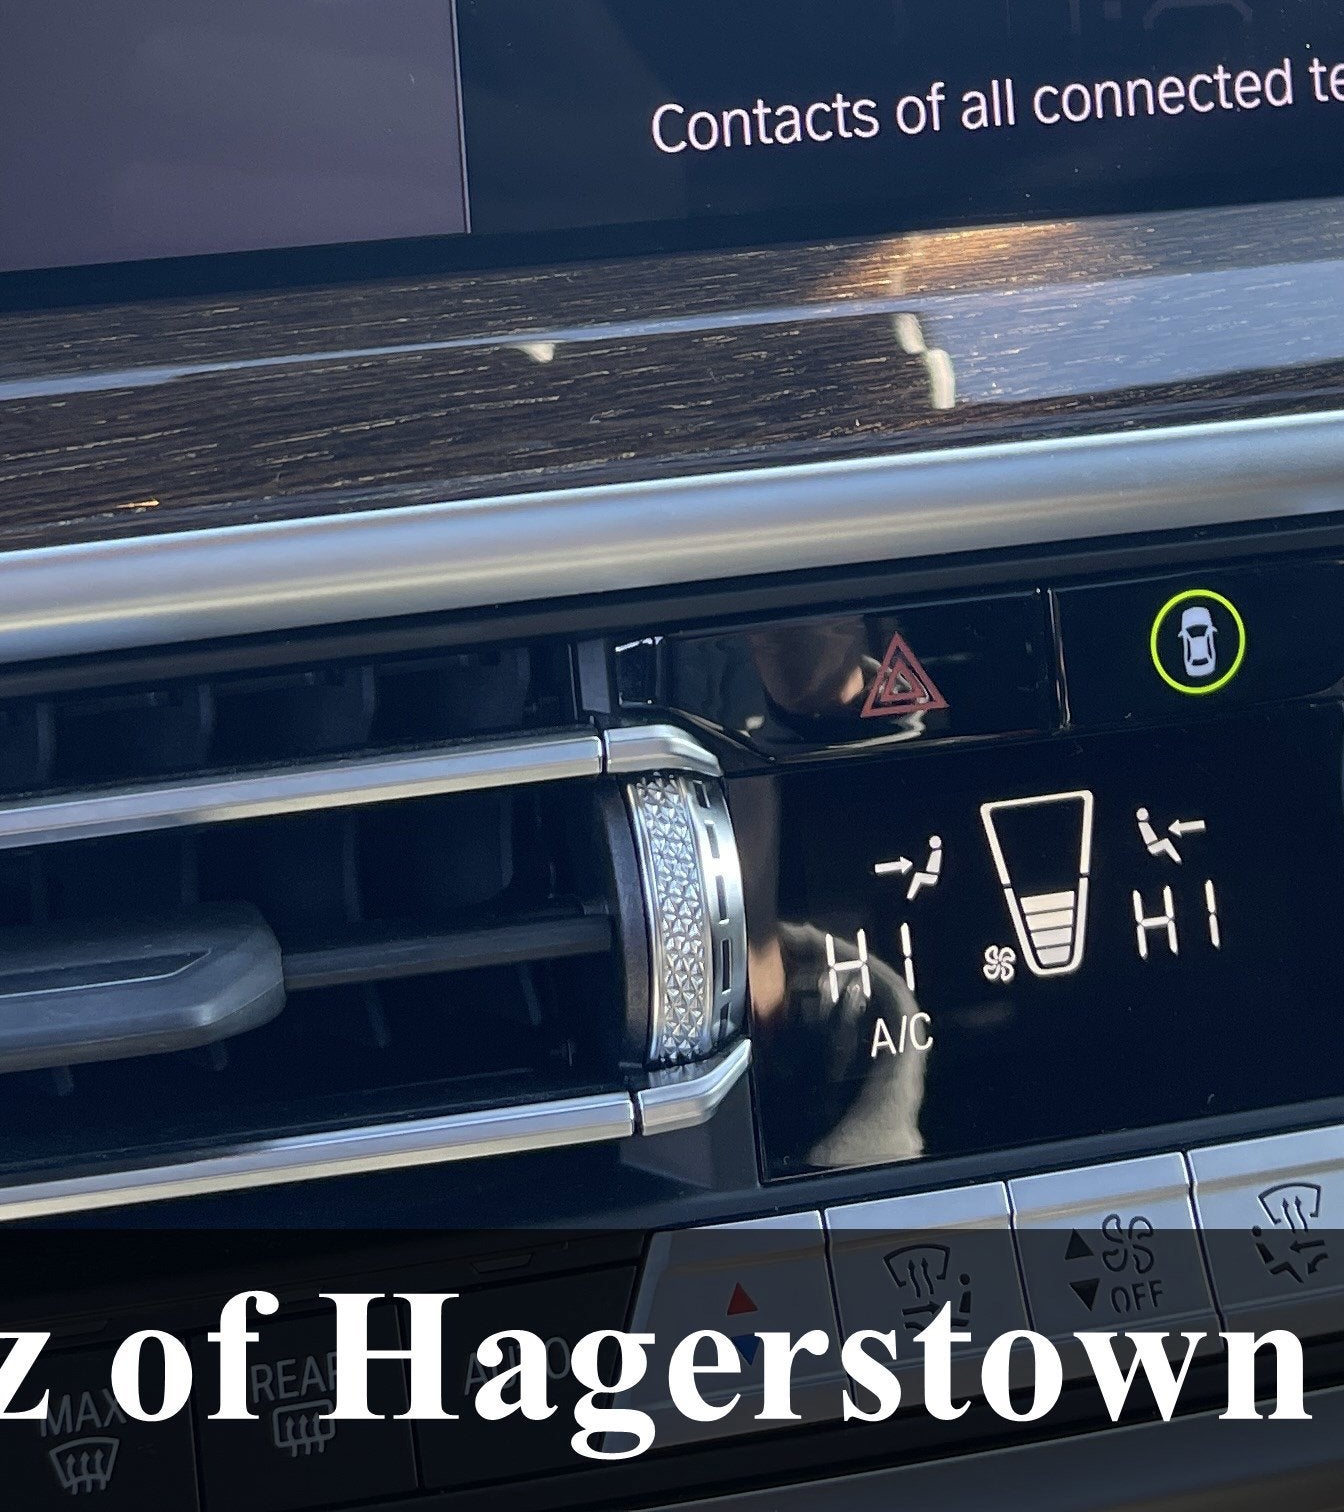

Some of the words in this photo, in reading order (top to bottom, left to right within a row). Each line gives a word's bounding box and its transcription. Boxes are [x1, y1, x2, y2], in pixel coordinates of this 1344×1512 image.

[652, 93, 880, 154] Contacts
[896, 81, 946, 135] of
[961, 78, 1015, 130] all
[1033, 57, 1293, 125] connected
[1133, 879, 1220, 959] HI
[823, 922, 916, 1003] HI
[870, 1010, 934, 1058] A/C
[1110, 1279, 1163, 1314] OFF
[464, 1335, 572, 1396] AUO
